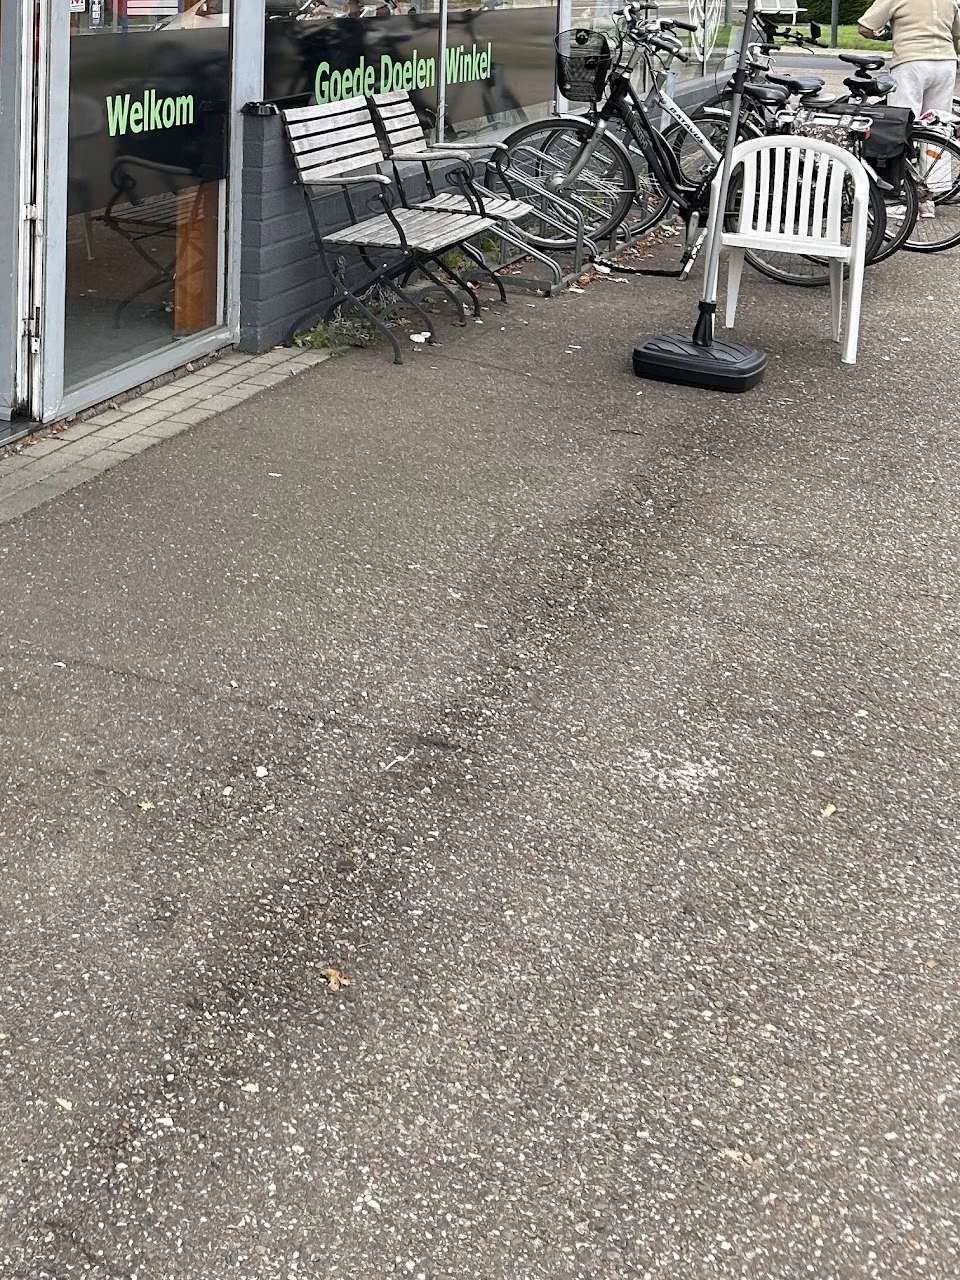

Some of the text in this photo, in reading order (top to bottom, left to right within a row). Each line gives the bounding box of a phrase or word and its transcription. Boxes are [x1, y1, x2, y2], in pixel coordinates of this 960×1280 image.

[314, 41, 492, 105] Goede Doelen Winkel
[106, 89, 194, 137] Welkom
[669, 107, 705, 145] BATAVUS
